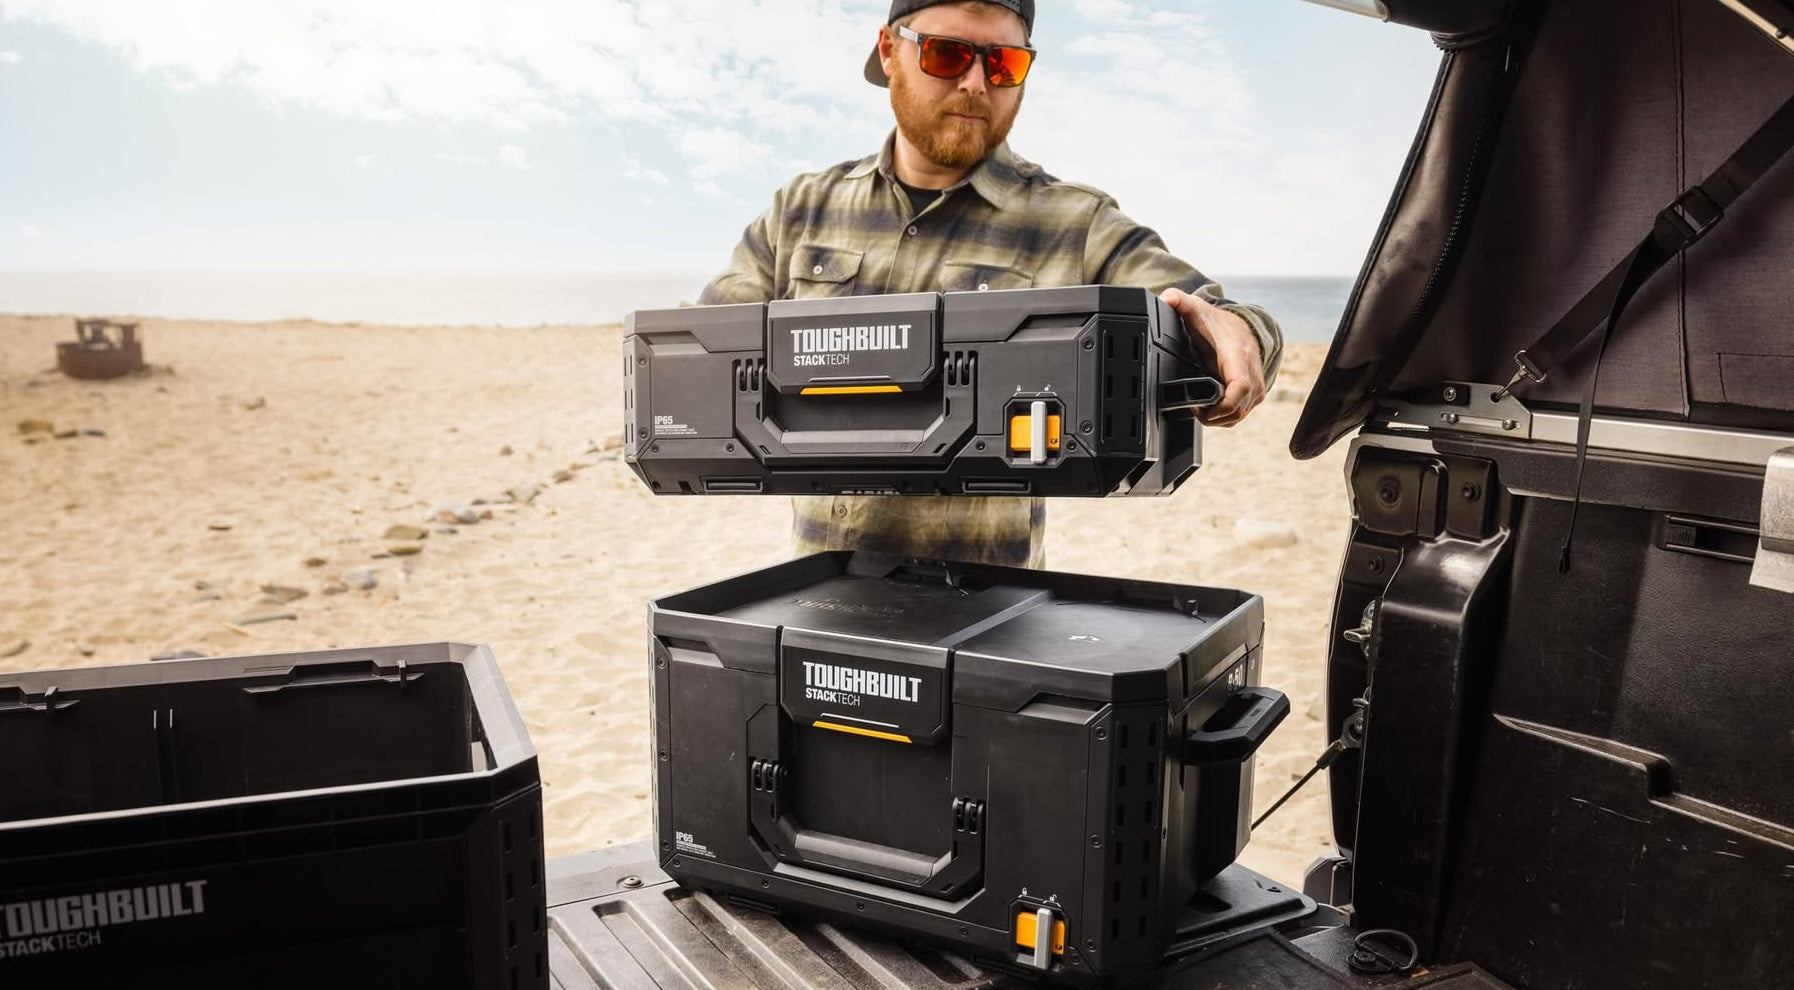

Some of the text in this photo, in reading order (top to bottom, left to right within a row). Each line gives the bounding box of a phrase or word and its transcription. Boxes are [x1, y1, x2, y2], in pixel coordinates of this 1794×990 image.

[791, 324, 912, 353] TOUGHBUILT
[793, 353, 850, 367] STACKTECH
[654, 415, 673, 425] IP65
[802, 661, 922, 703] TOUGHBUILT
[805, 687, 861, 707] STACKTECH
[675, 830, 694, 843] IP65
[0, 880, 207, 938] OUGHBUILT
